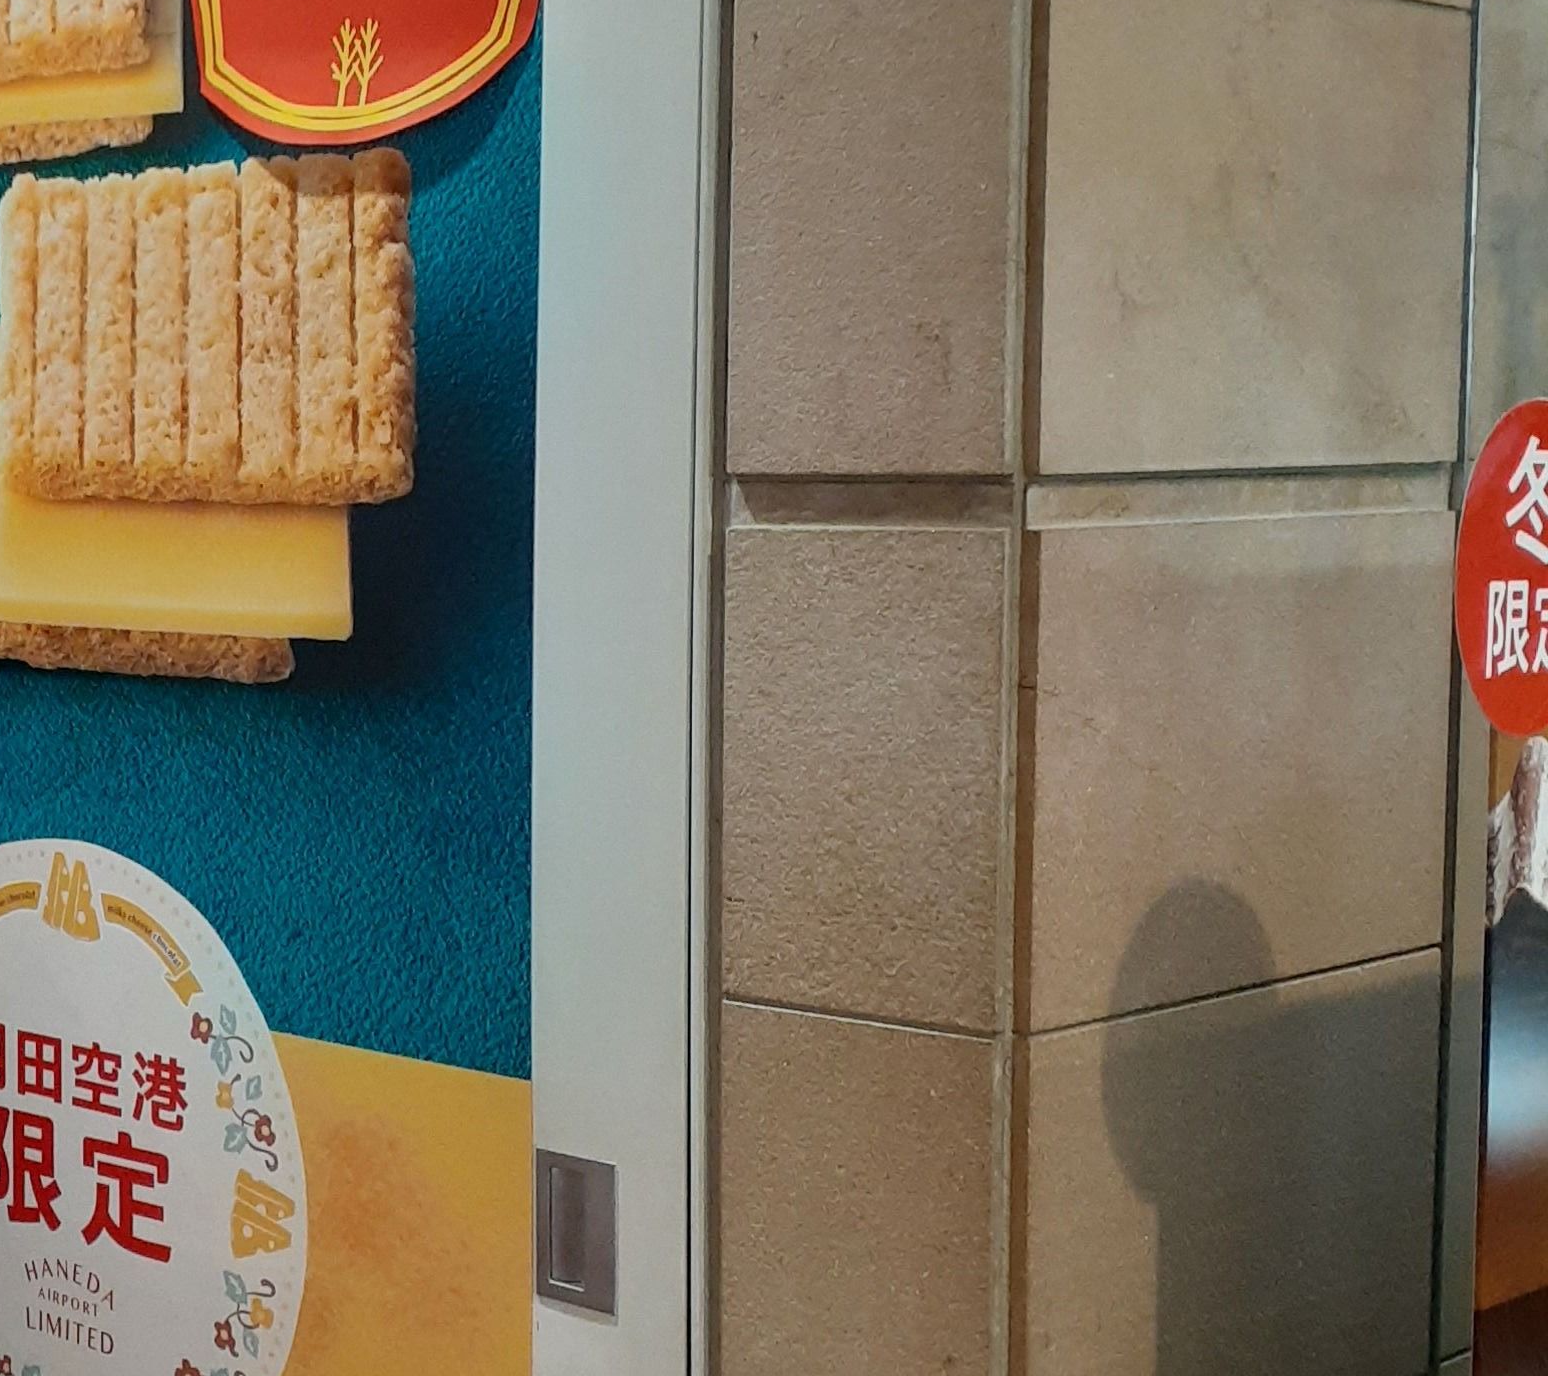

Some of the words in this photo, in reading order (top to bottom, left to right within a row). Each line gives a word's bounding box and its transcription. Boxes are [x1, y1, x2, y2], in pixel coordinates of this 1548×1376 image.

[24, 1257, 114, 1311] HANEDA
[37, 1286, 98, 1317] AIRPORT
[25, 1306, 114, 1354] LIMITED
